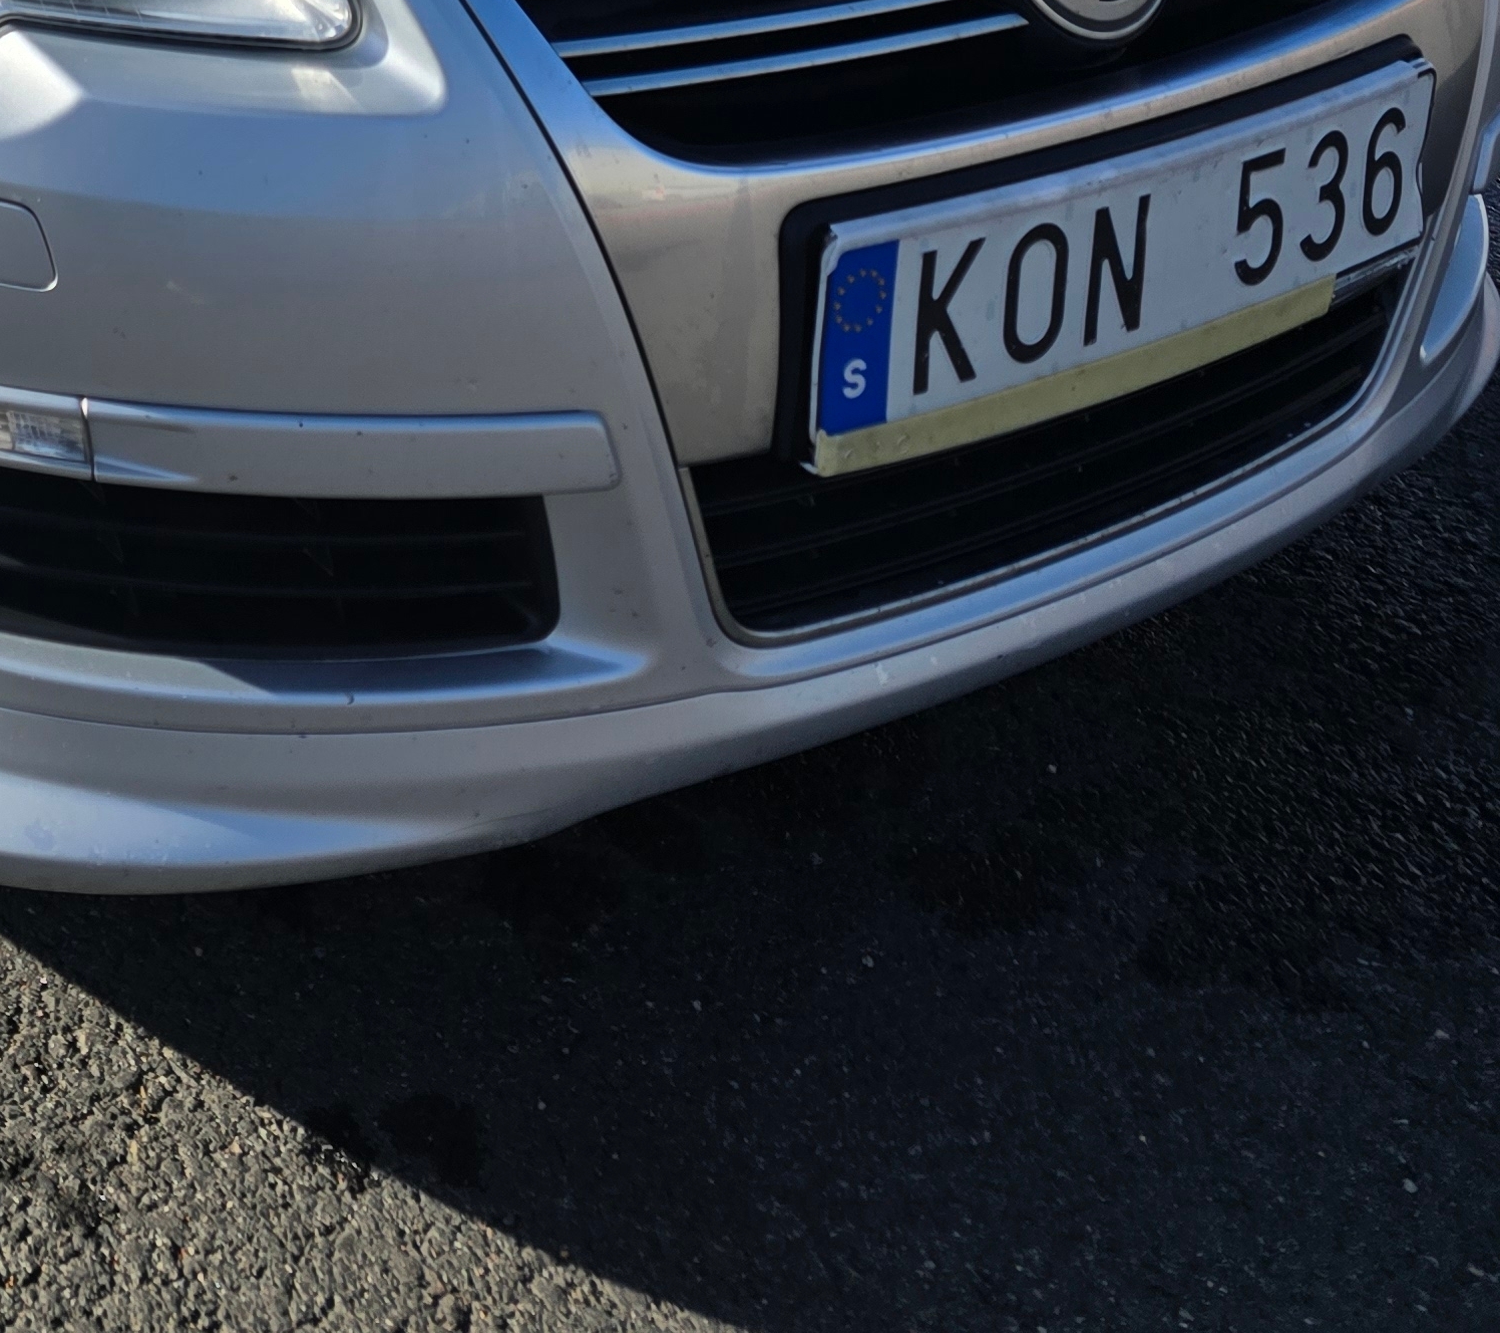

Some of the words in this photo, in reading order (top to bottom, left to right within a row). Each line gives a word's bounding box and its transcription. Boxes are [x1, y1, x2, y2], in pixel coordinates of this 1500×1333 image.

[912, 194, 1151, 395] KON
[1234, 106, 1407, 286] 536
[842, 358, 867, 399] S
